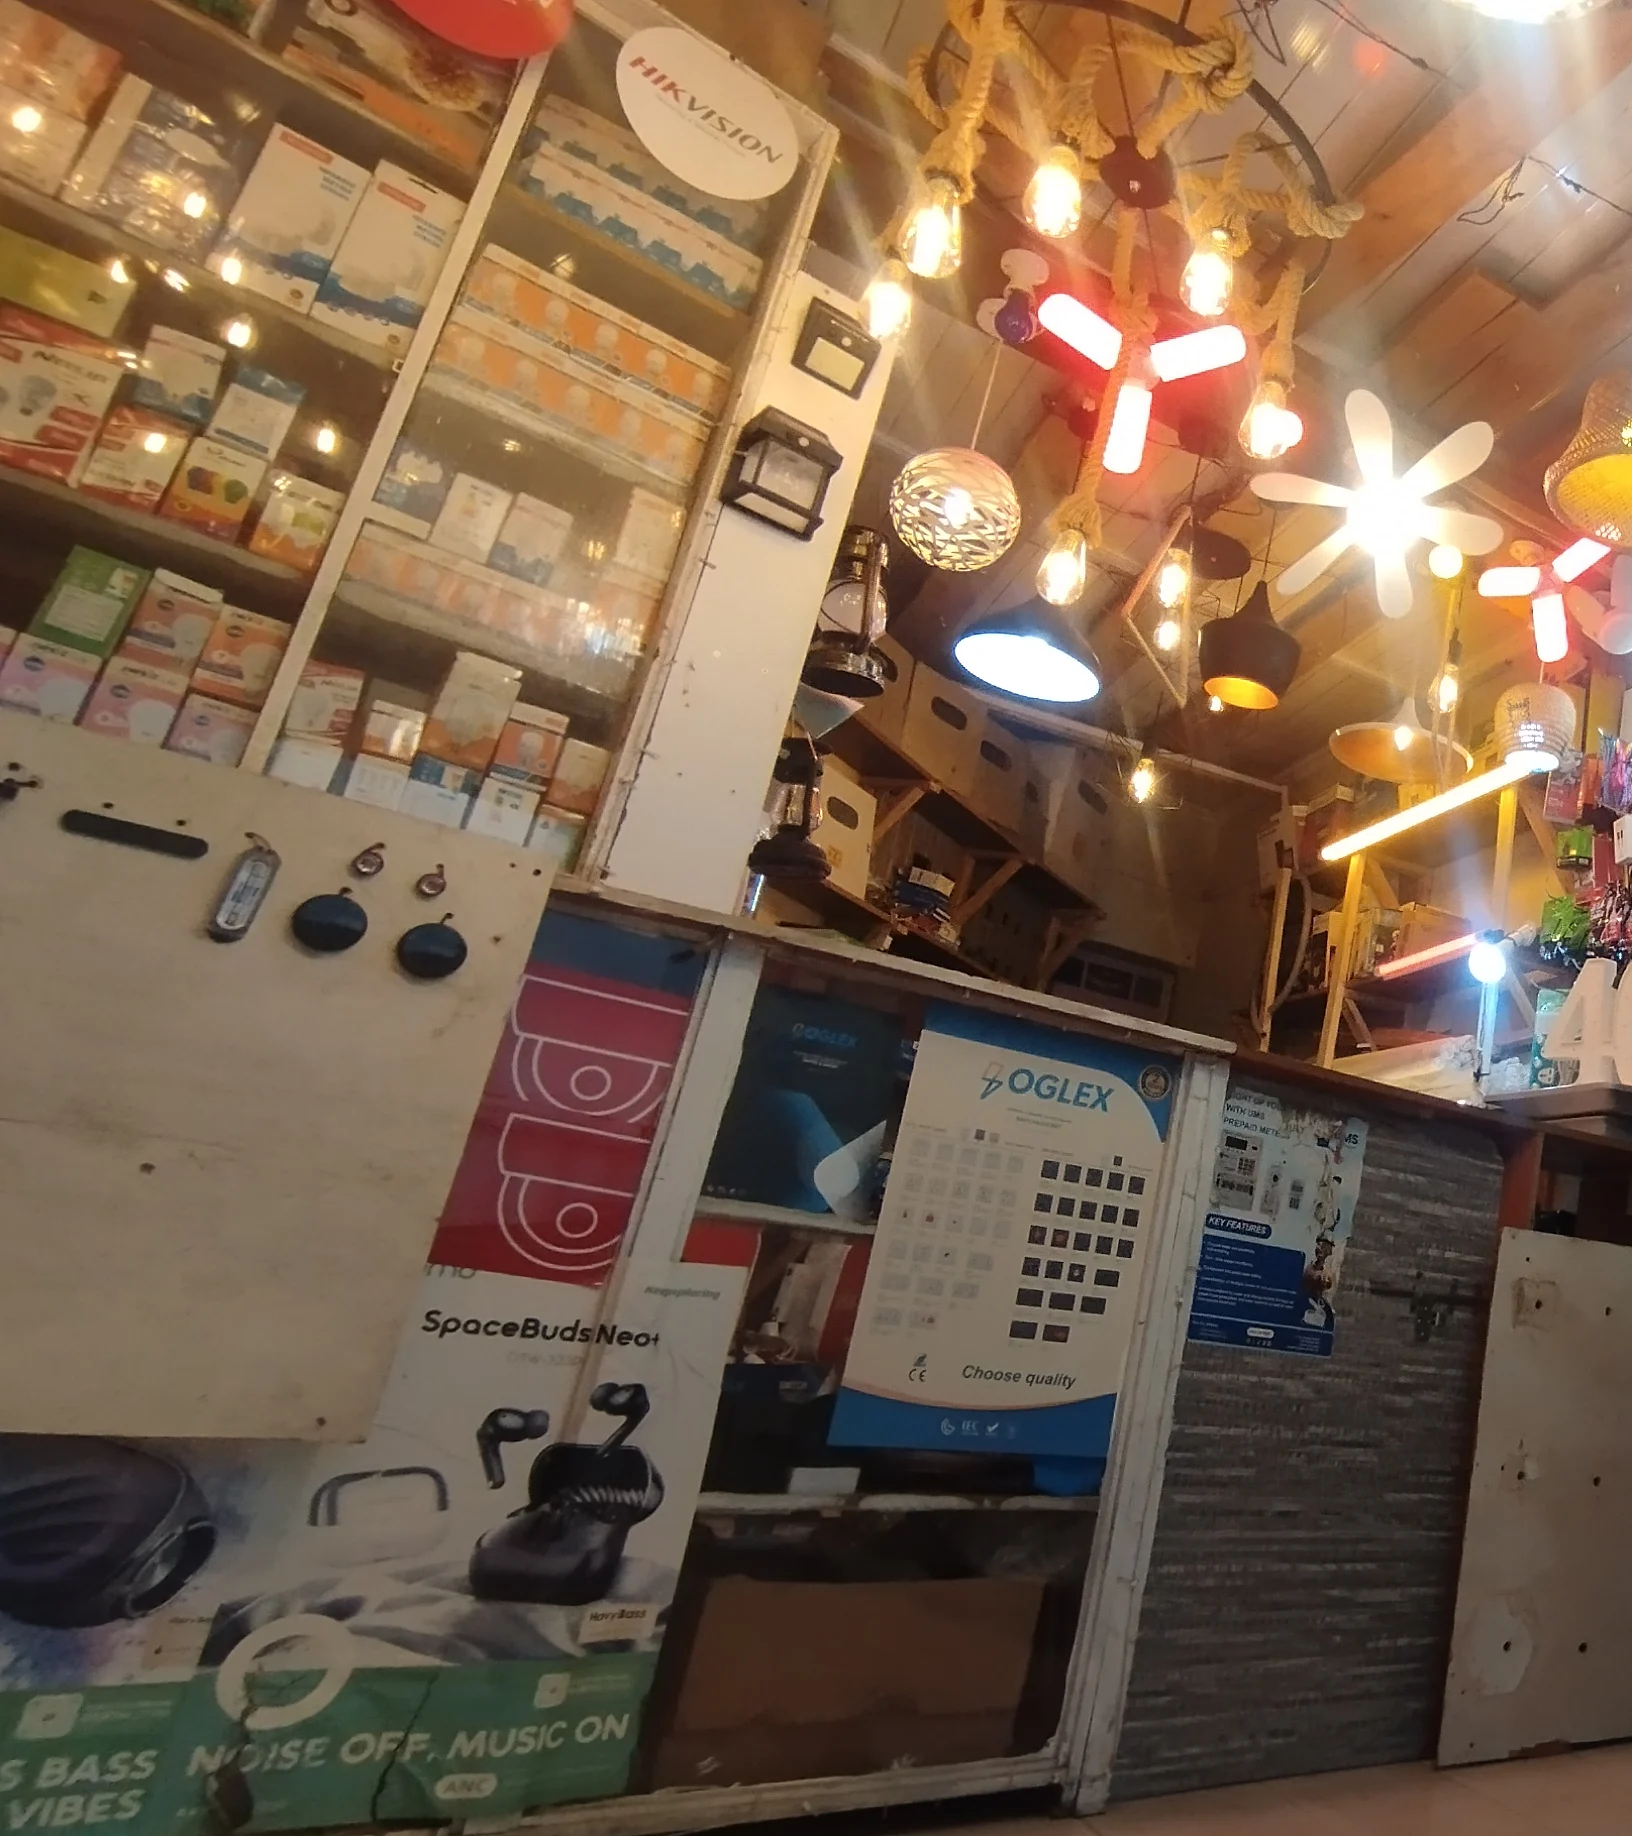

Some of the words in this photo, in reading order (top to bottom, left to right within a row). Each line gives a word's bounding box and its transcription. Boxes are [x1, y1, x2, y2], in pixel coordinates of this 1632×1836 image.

[629, 56, 783, 163] HIKVISION
[804, 1027, 859, 1048] OGLEX
[1008, 1068, 1115, 1112] OGLEX
[1226, 1103, 1246, 1115] WITH
[1223, 1117, 1258, 1132] PREPAID
[1208, 1216, 1226, 1227] KEY
[1226, 1220, 1267, 1235] FEATURES
[962, 1364, 1021, 1383] Choose
[1025, 1371, 1077, 1391] quality
[446, 1720, 568, 1759] MUSIC
[574, 1713, 630, 1743] ON
[34, 1749, 159, 1789] BASS
[442, 1779, 489, 1795] ANC
[8, 1789, 147, 1830] VIBES
